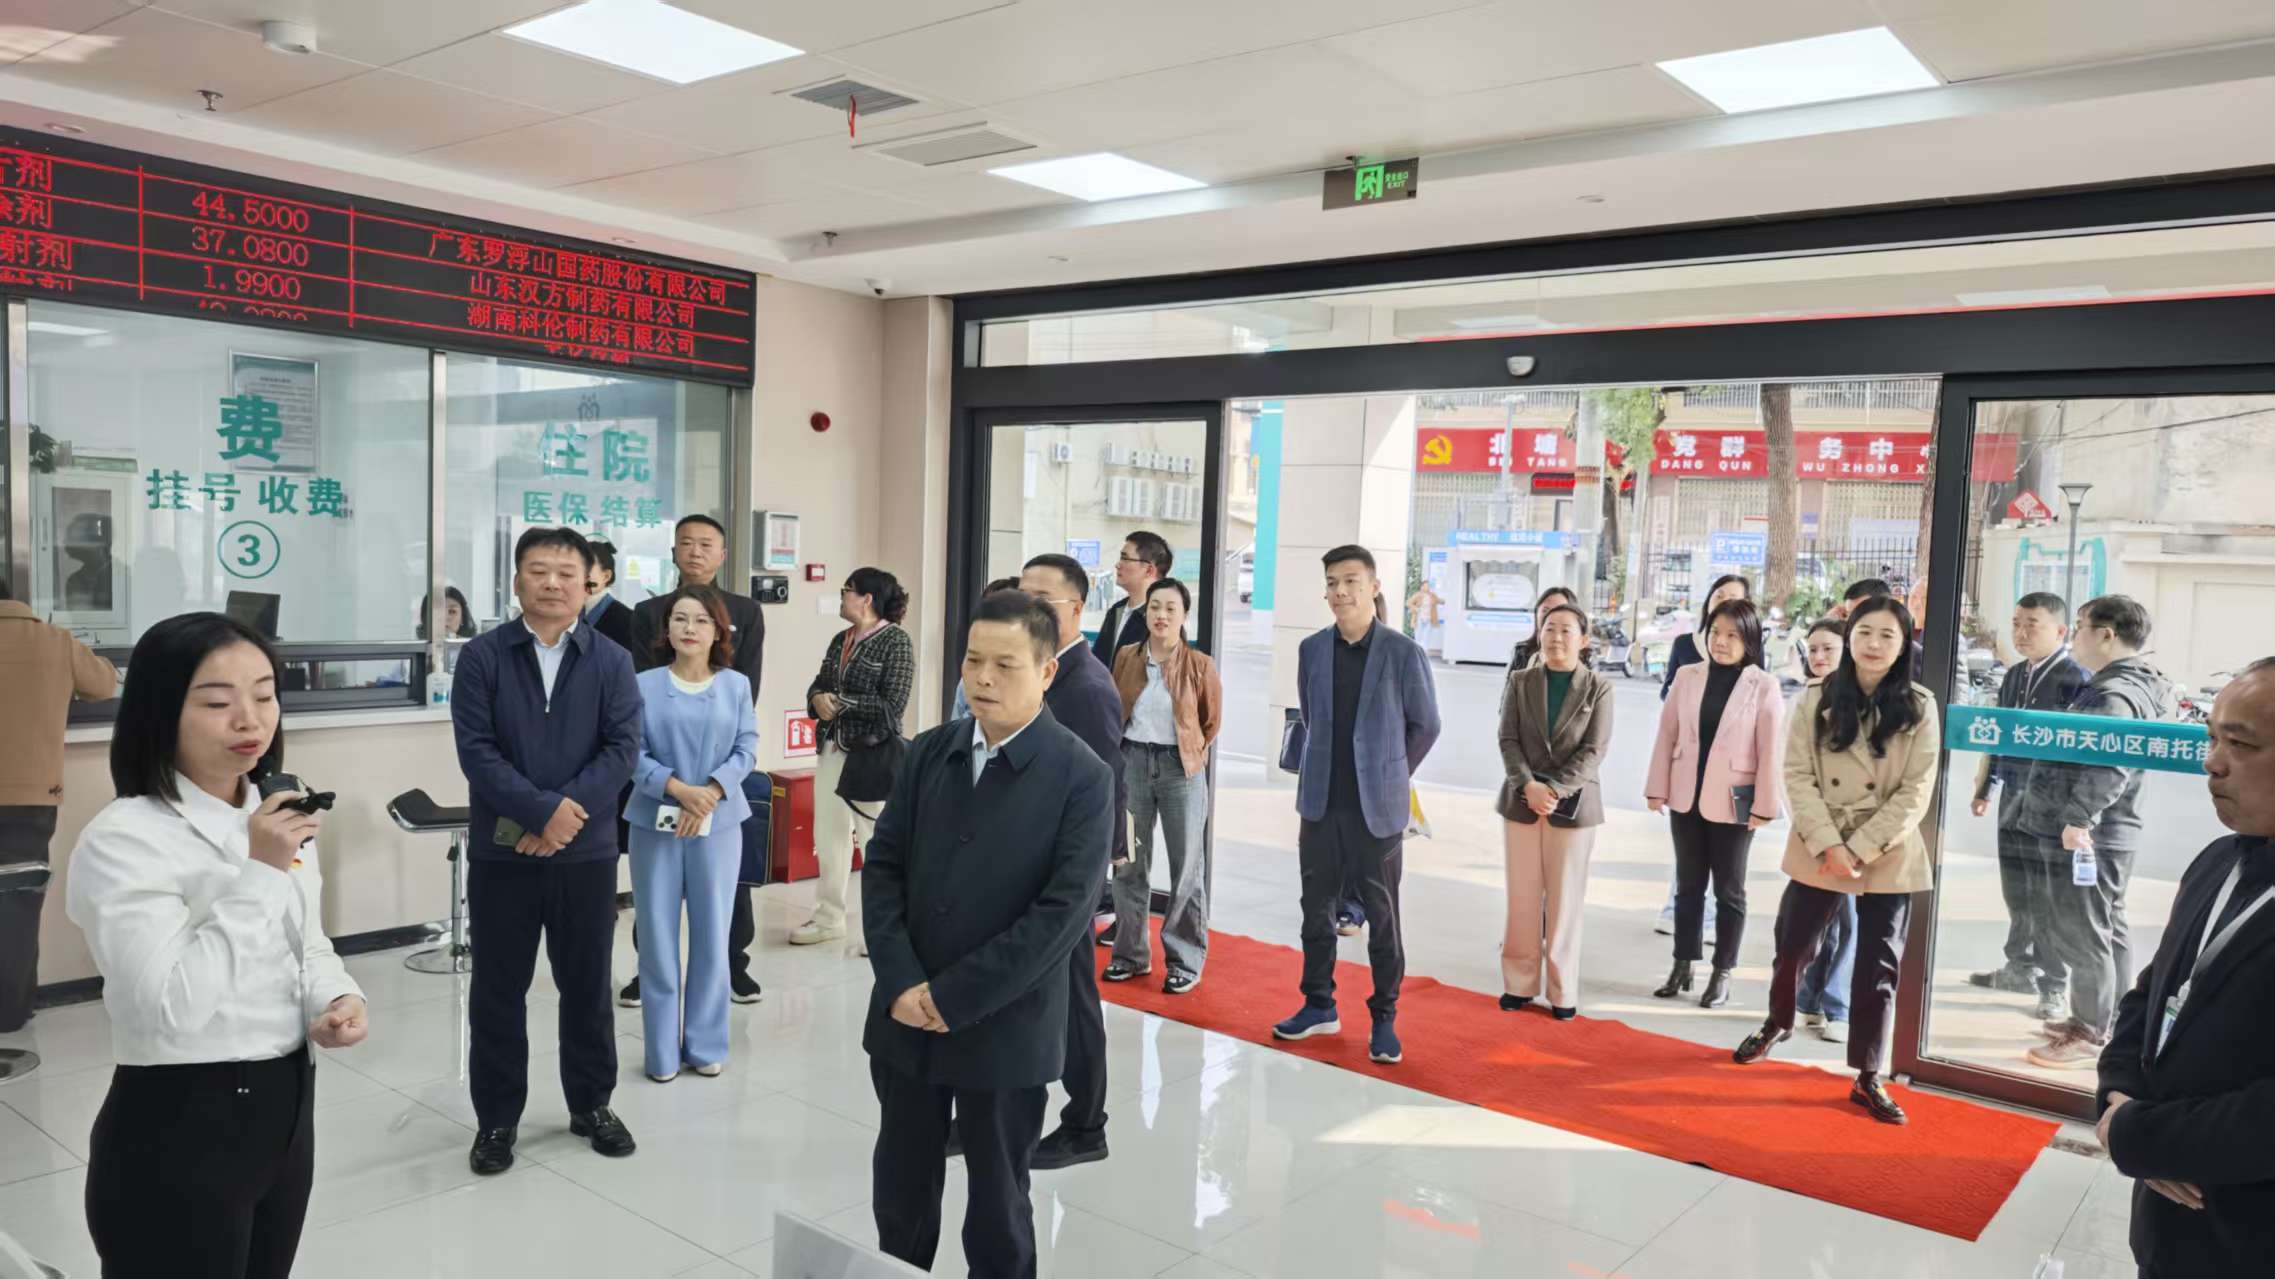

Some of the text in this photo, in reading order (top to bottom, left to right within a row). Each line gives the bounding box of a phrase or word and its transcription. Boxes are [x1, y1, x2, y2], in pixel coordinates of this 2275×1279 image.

[192, 191, 310, 233] 44.5000
[192, 227, 310, 268] 37.0800
[428, 232, 727, 306] 广东罗浮山国药股份有限公司
[203, 265, 301, 300] 1.9900
[470, 271, 696, 329] 山东汉方制药有限公司
[467, 302, 696, 357] 湖南科伦制药有限公司
[217, 394, 284, 463] 费
[539, 420, 651, 483] 住院
[1526, 457, 1568, 468] TANG
[1660, 459, 1704, 470] DANG
[1718, 460, 1752, 471] QUN
[1802, 463, 1825, 473] WU
[1841, 464, 1899, 474] ZHONG
[523, 491, 663, 528] 医保结算
